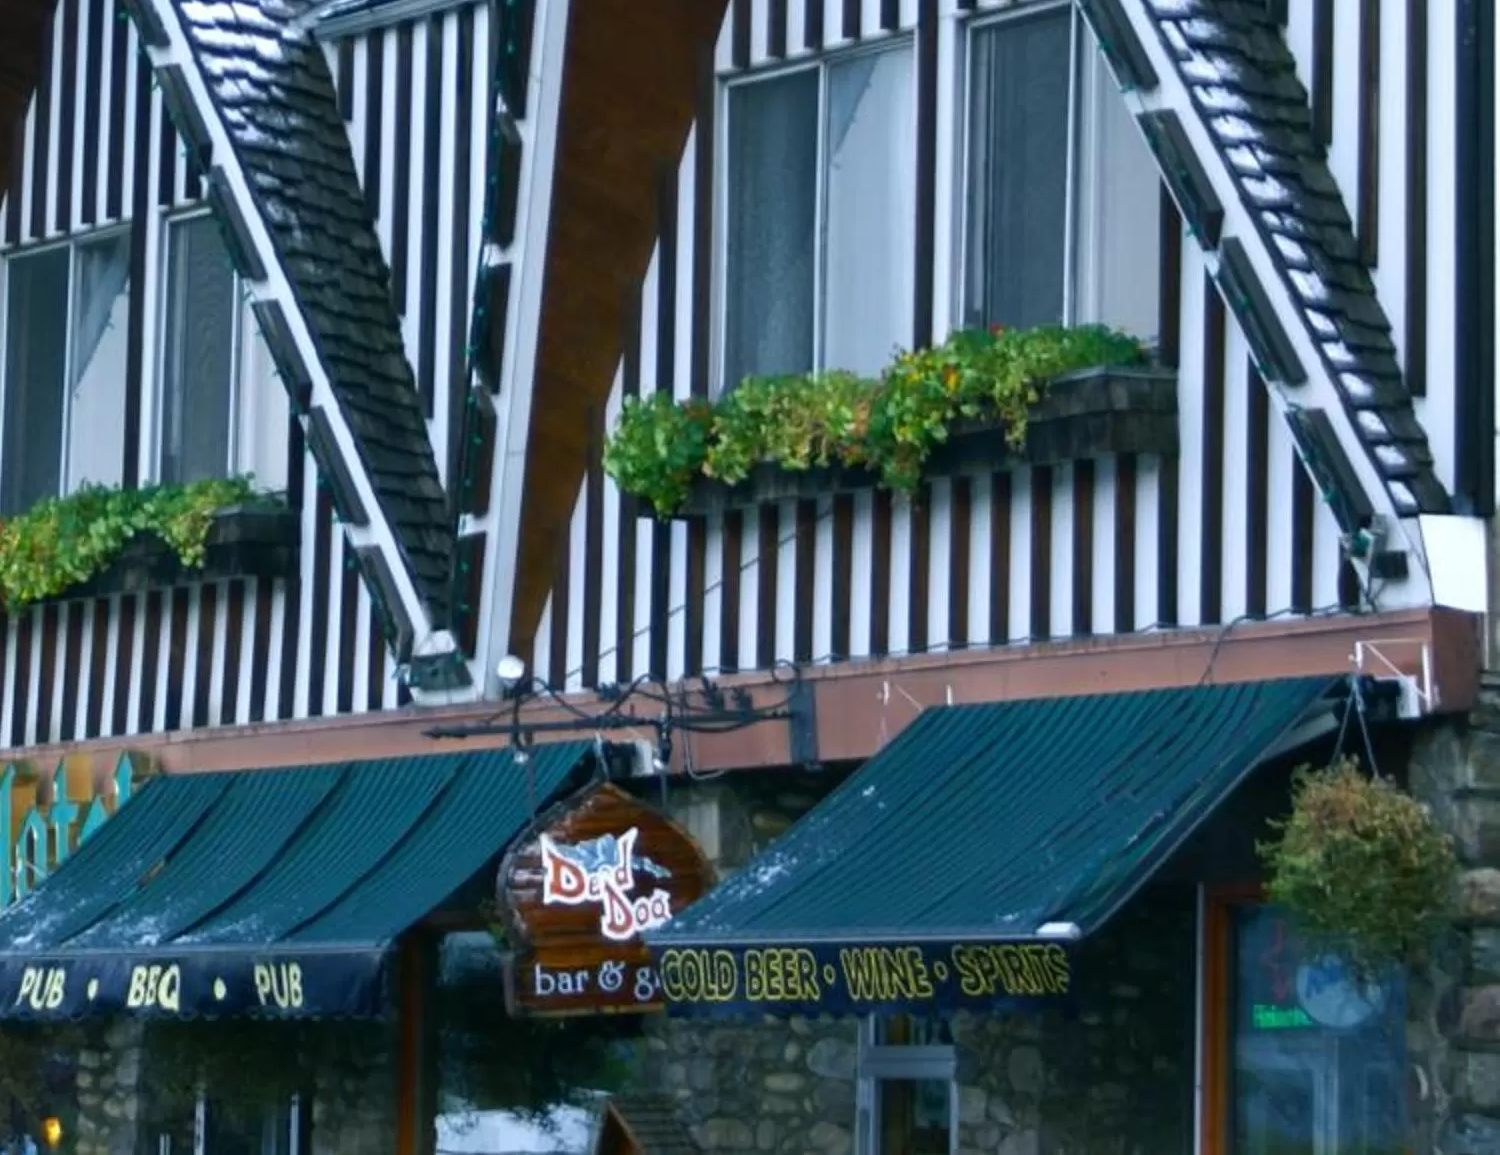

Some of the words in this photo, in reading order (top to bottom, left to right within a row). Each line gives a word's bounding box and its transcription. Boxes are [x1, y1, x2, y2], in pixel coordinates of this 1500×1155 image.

[540, 827, 640, 905] Dead
[15, 967, 65, 1009] PUB
[127, 964, 179, 1011] BBQ
[254, 962, 302, 1008] PUB
[535, 964, 589, 996] bar
[598, 961, 625, 990] &
[660, 949, 737, 1002] COLD
[744, 947, 819, 1001] BEER
[840, 946, 934, 1000] WINE
[952, 943, 1070, 996] SPIRITS
